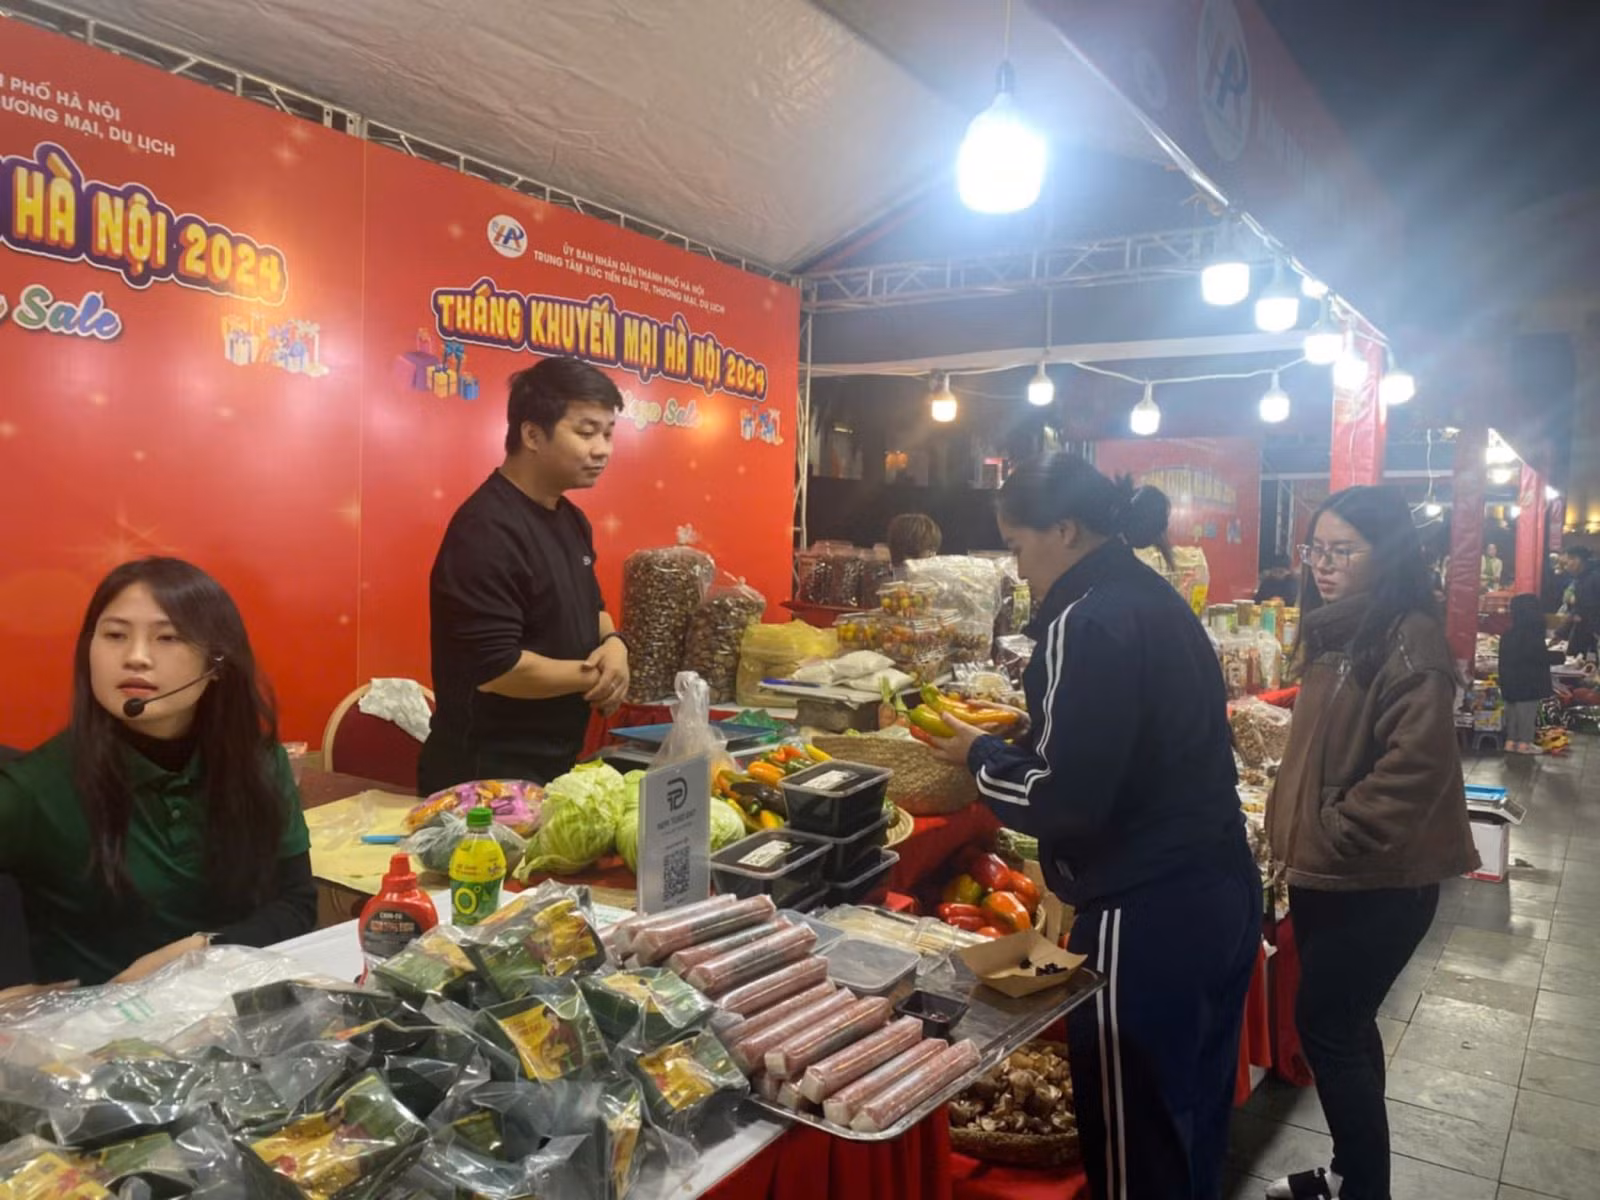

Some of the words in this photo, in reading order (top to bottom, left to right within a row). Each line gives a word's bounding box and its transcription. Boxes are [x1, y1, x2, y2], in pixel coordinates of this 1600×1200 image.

[56, 90, 82, 111] HÀ
[88, 99, 121, 122] NỘI
[64, 113, 104, 139] MẠI,
[109, 126, 132, 145] DU
[138, 135, 175, 157] LỊCH
[13, 152, 76, 247] HÀ
[92, 191, 167, 276] NỘI
[180, 222, 283, 295] 2024
[534, 250, 563, 267] TRUNG
[564, 258, 583, 273] TÂM
[576, 249, 594, 262] BAN
[13, 284, 122, 340] Sale
[437, 283, 522, 343] THÁNG
[531, 299, 616, 361] KHUYẾN
[623, 316, 658, 375] MẠI
[664, 318, 688, 376] HÀ
[693, 337, 721, 389] NỘI
[725, 353, 766, 397] 2024
